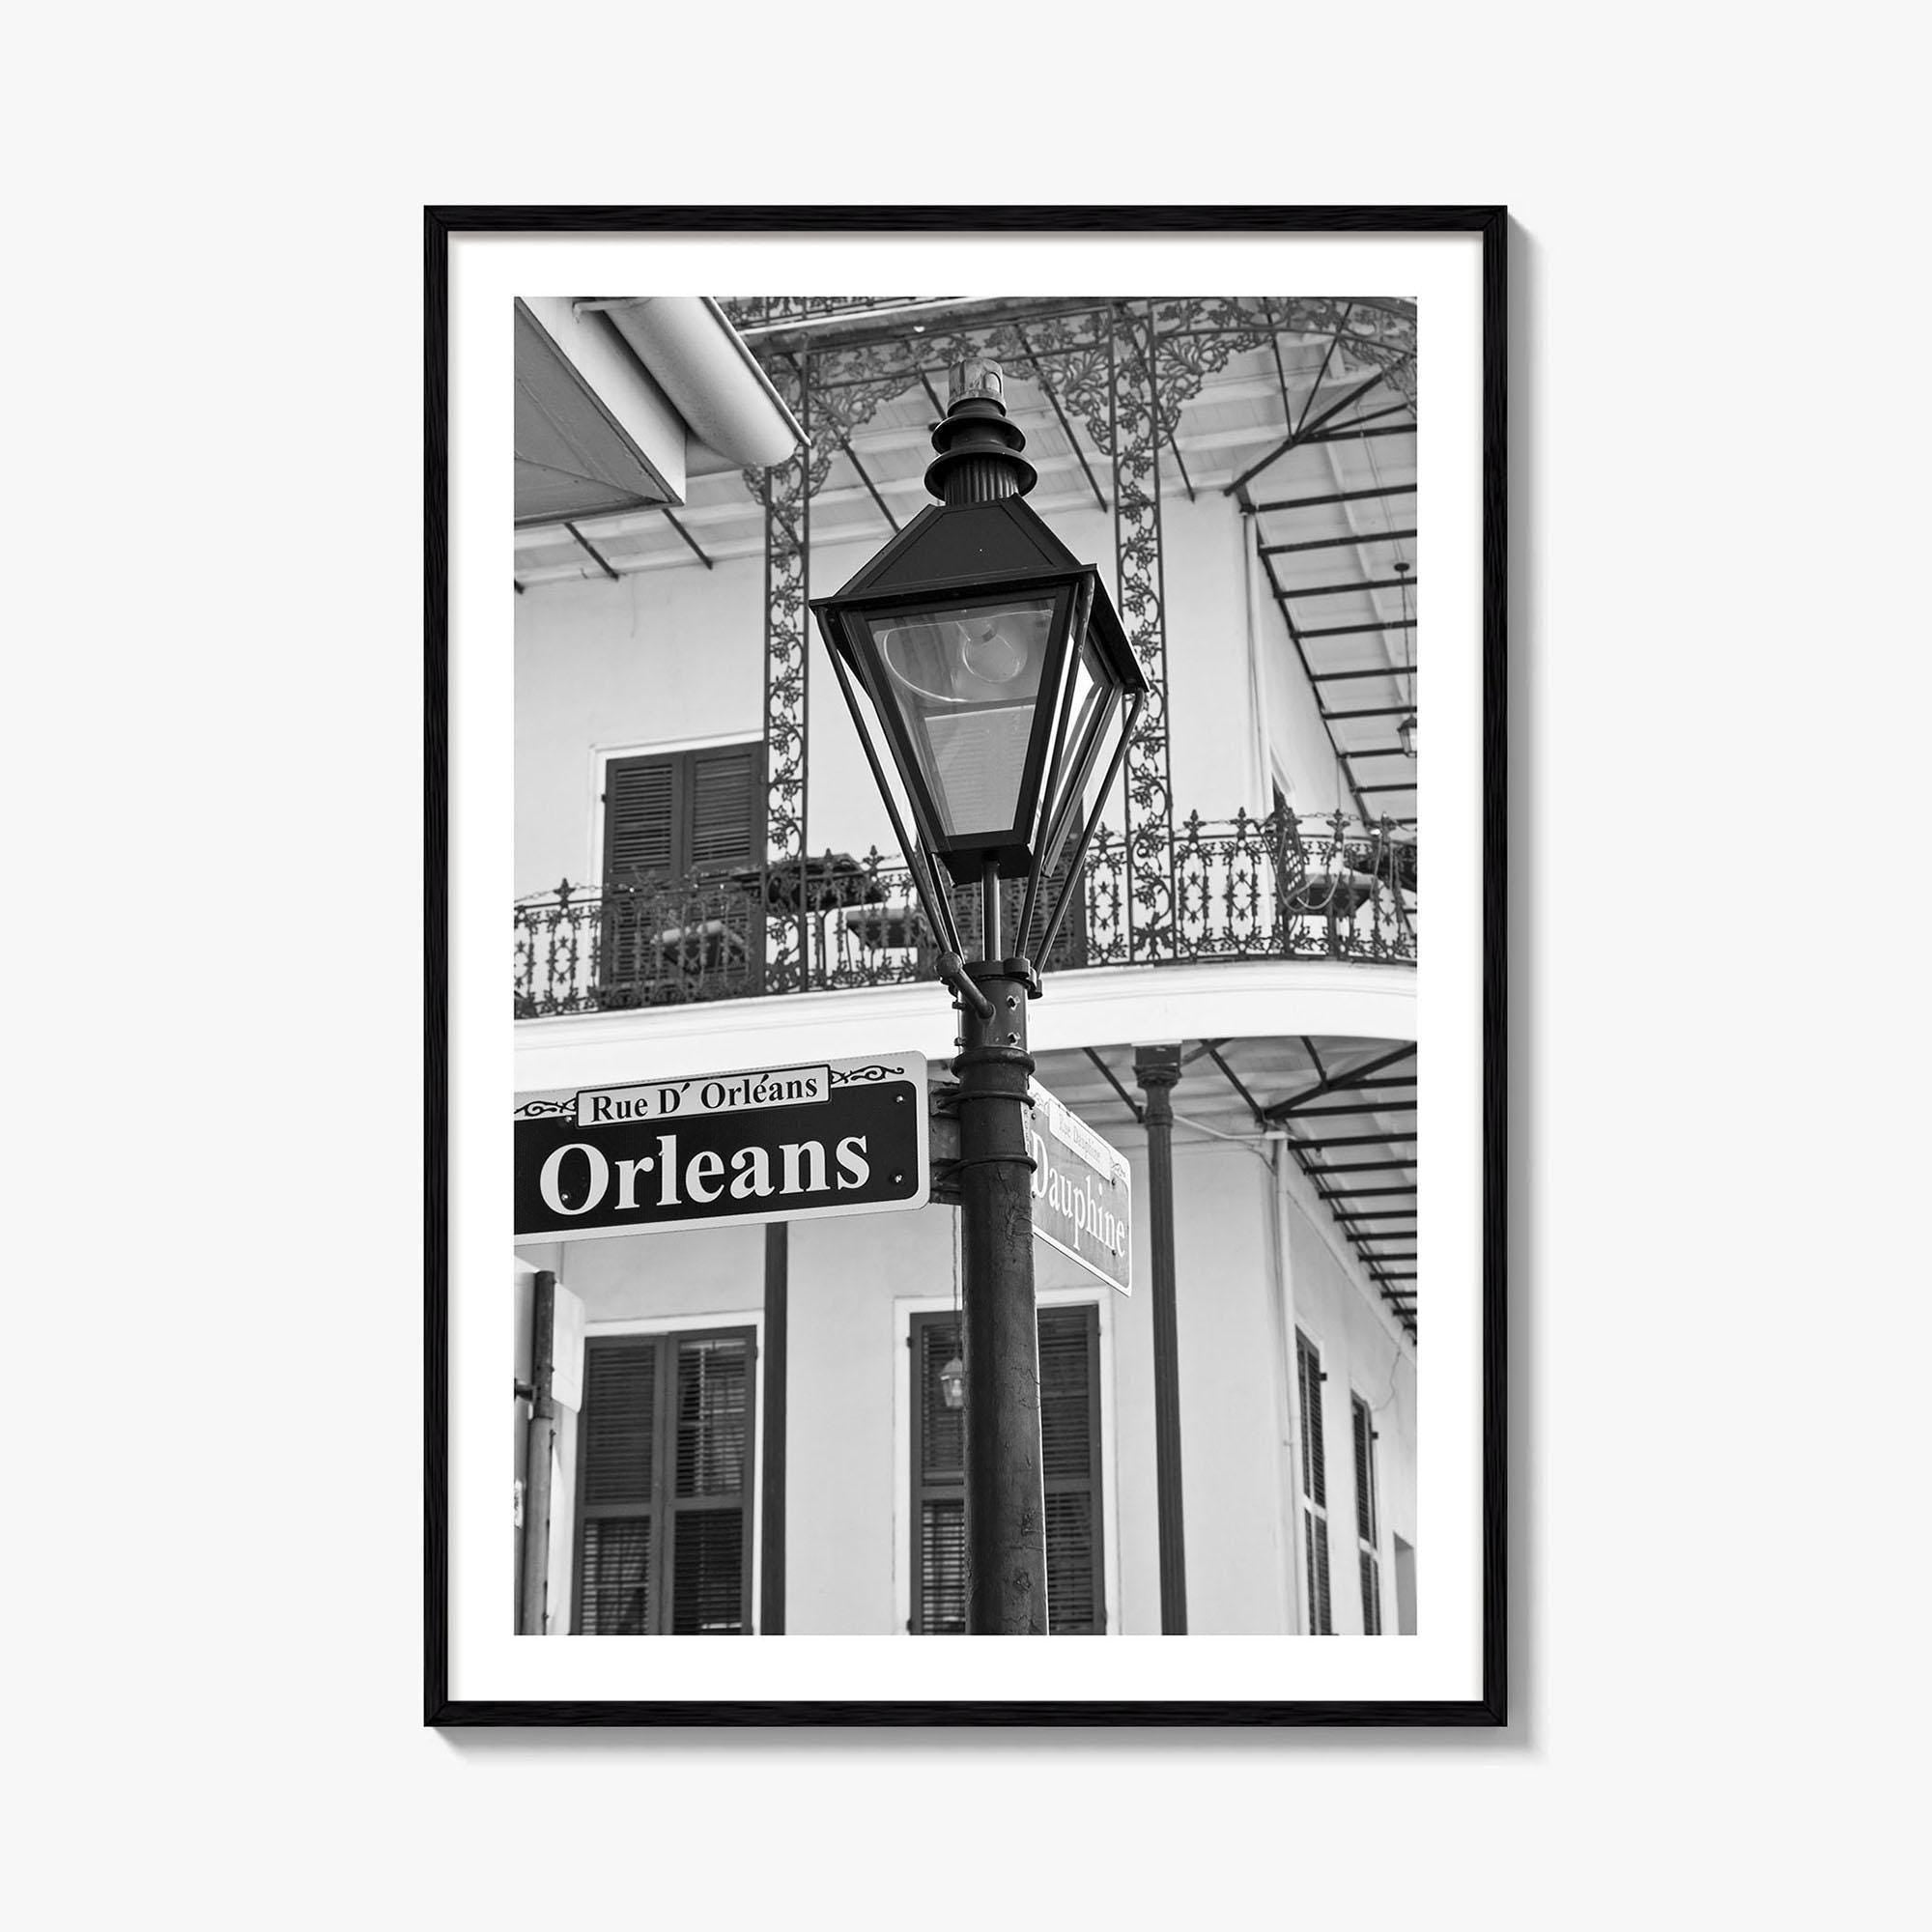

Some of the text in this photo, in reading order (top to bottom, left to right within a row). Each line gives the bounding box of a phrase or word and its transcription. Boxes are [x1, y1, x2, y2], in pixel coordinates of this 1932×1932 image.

[590, 1094, 649, 1122] Rue
[700, 1073, 819, 1109] Orléans
[539, 1134, 871, 1216] Orleans
[1031, 1129, 1126, 1257] Dauphine
